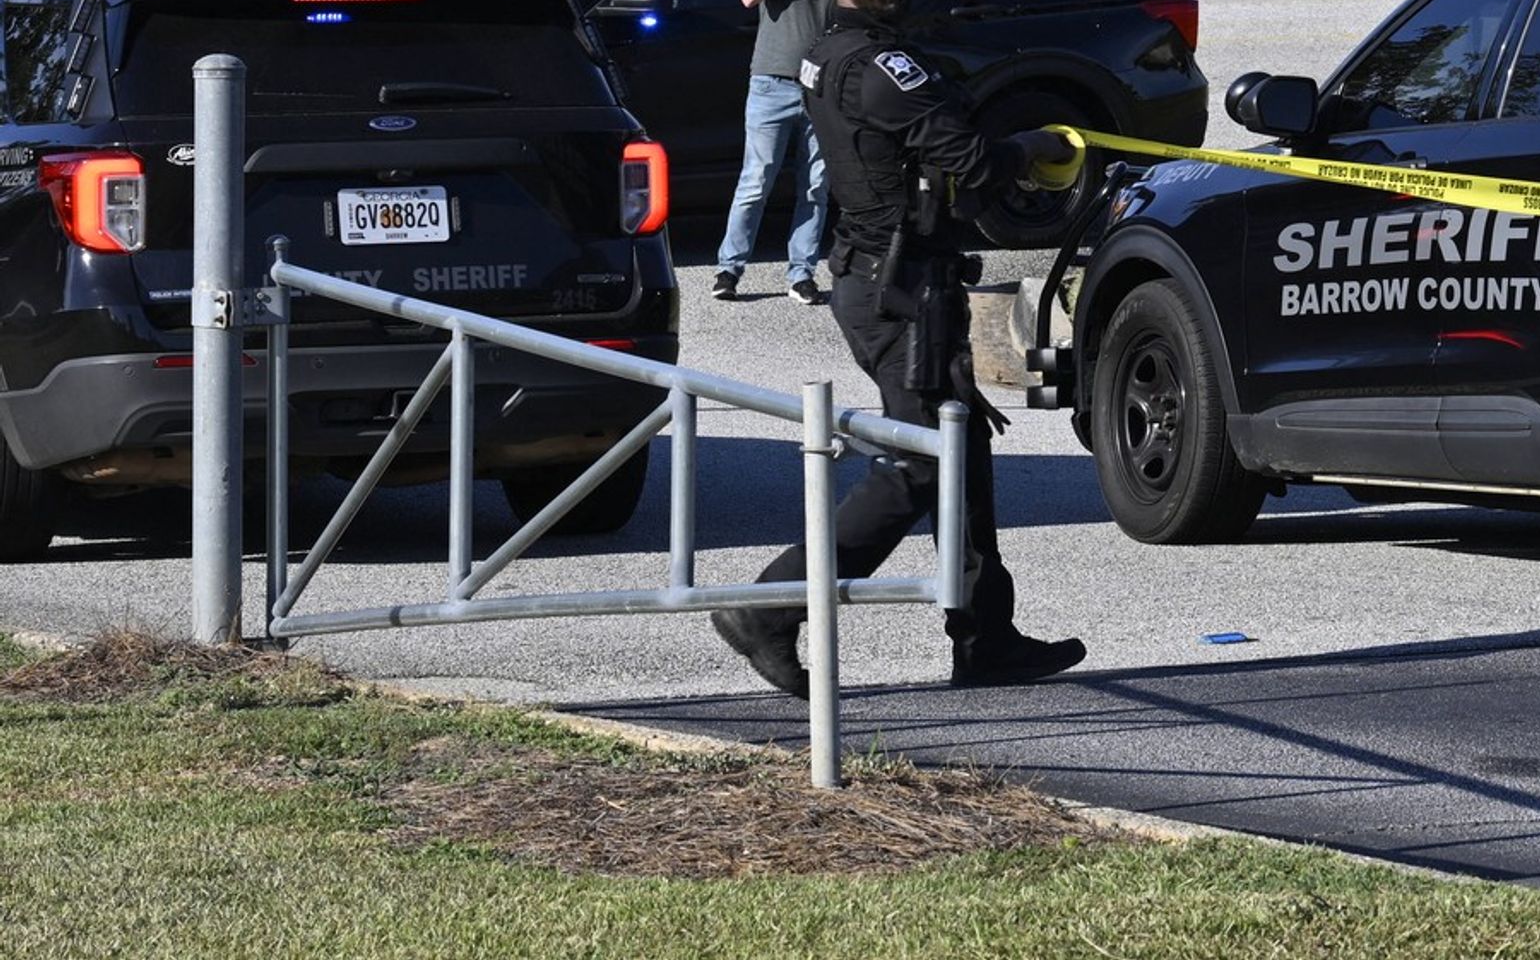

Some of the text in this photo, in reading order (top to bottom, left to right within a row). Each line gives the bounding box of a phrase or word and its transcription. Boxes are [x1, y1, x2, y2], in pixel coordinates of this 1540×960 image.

[1318, 164, 1472, 190] LINEA DE POLICIA POR FAVOR NO CRUZAR
[1498, 183, 1530, 196] CRUZAR
[363, 191, 420, 202] GEORGIA
[413, 264, 528, 292] SHERIFF
[1280, 278, 1408, 316] BARROW
